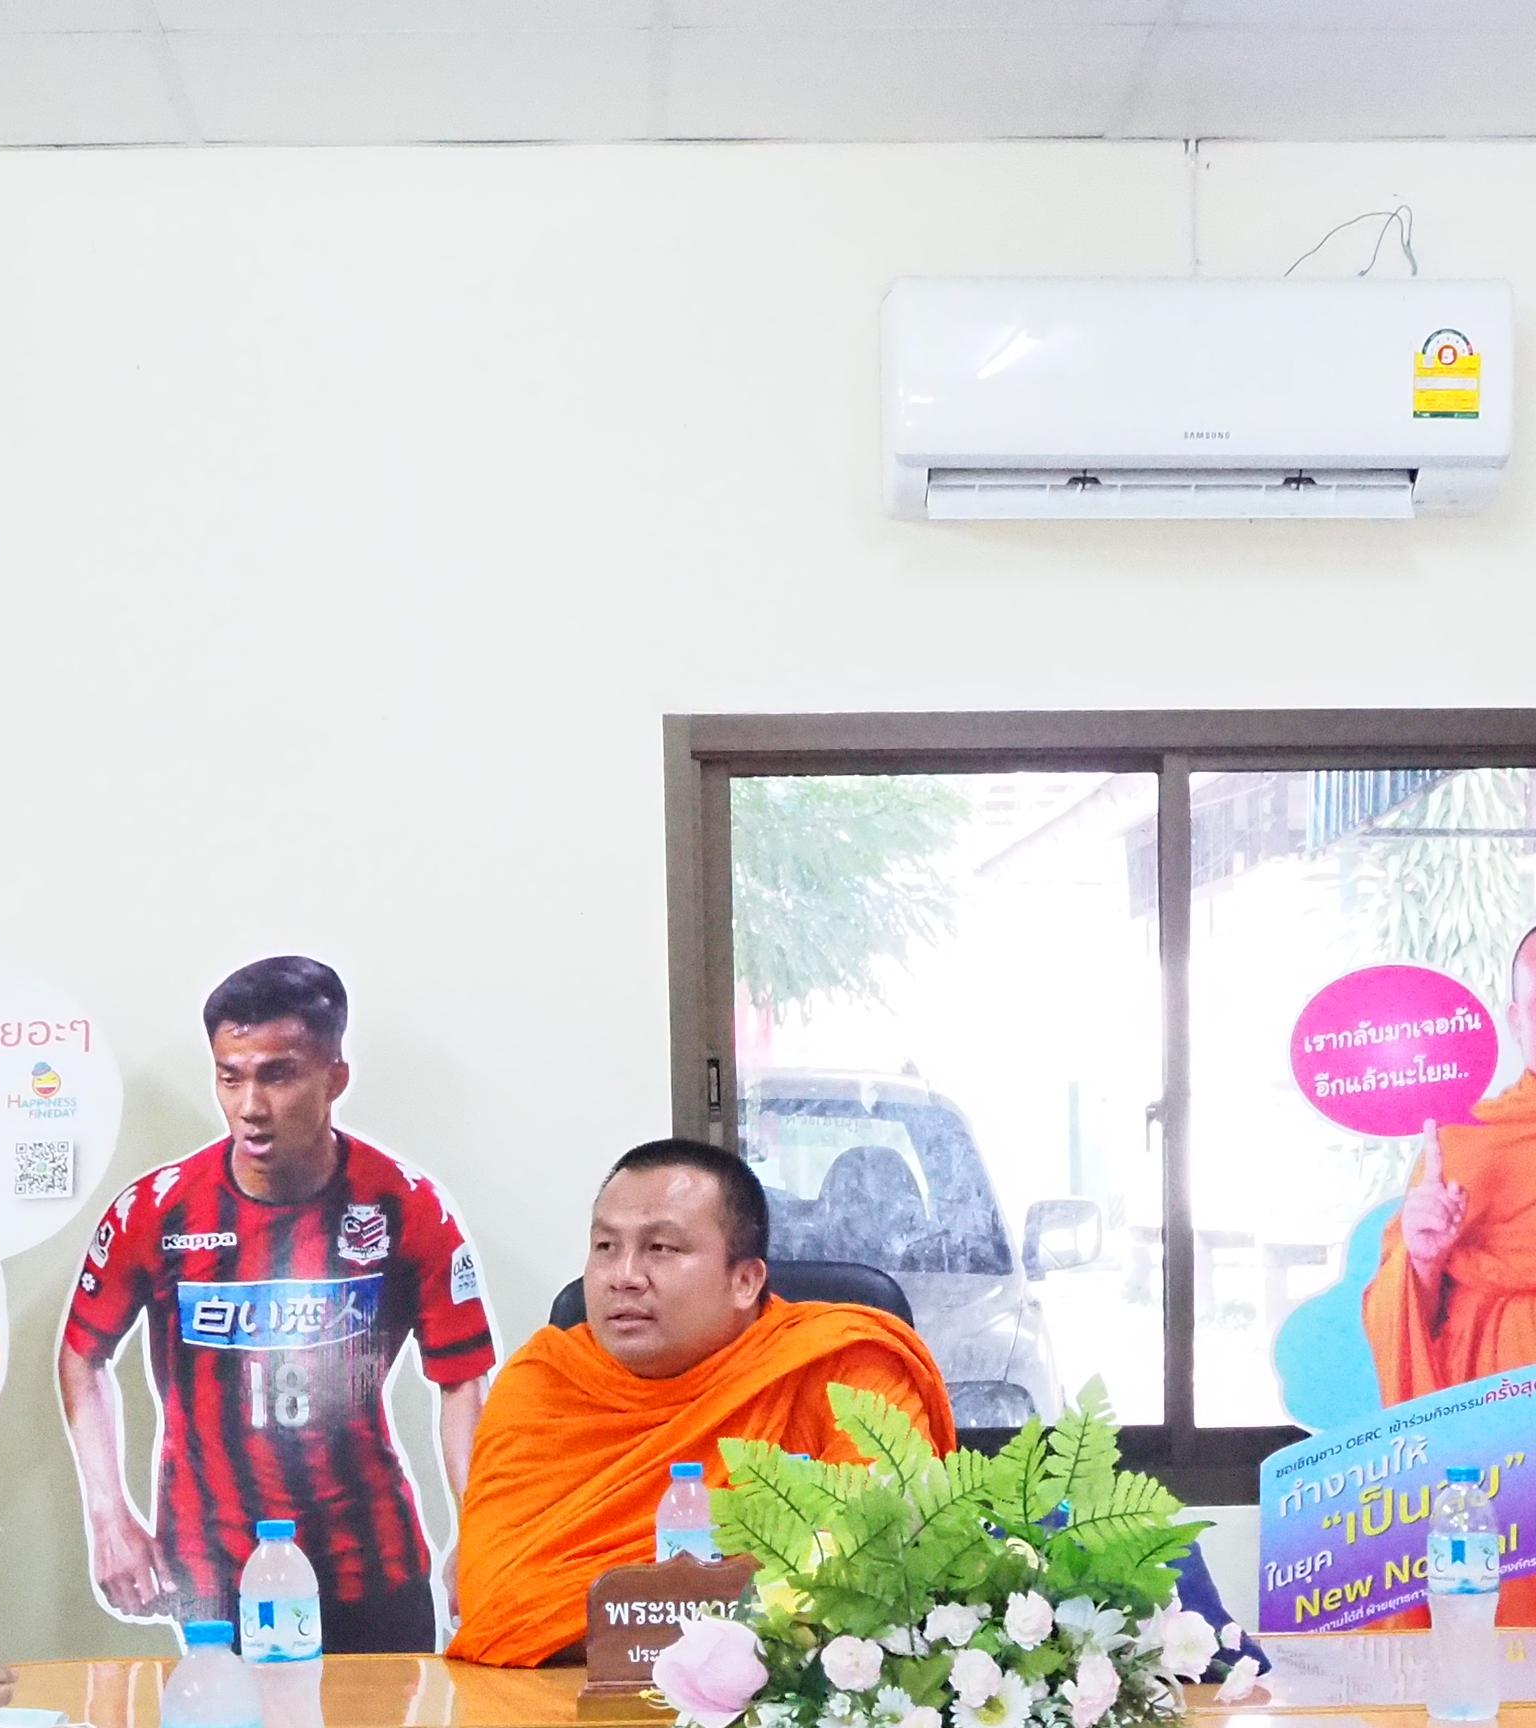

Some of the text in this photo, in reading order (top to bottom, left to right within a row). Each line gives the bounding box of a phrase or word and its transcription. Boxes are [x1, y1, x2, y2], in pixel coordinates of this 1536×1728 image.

[1184, 431, 1231, 440] SAMSUNG
[1304, 1007, 1482, 1053] เรากลับมาเจอกัน
[1314, 1054, 1469, 1097] อีกแล้วนะโยม..
[162, 1232, 238, 1251] Kappa
[193, 1291, 363, 1333] 白い恋人
[251, 1362, 311, 1429] 18
[1276, 1444, 1342, 1479] ขอเชิญชาว
[1346, 1428, 1383, 1450] OERC
[1280, 1435, 1429, 1518] ทำงานให้
[1265, 1550, 1333, 1592] ในยุค
[1295, 1575, 1374, 1624] New
[628, 1645, 663, 1663] ประ
